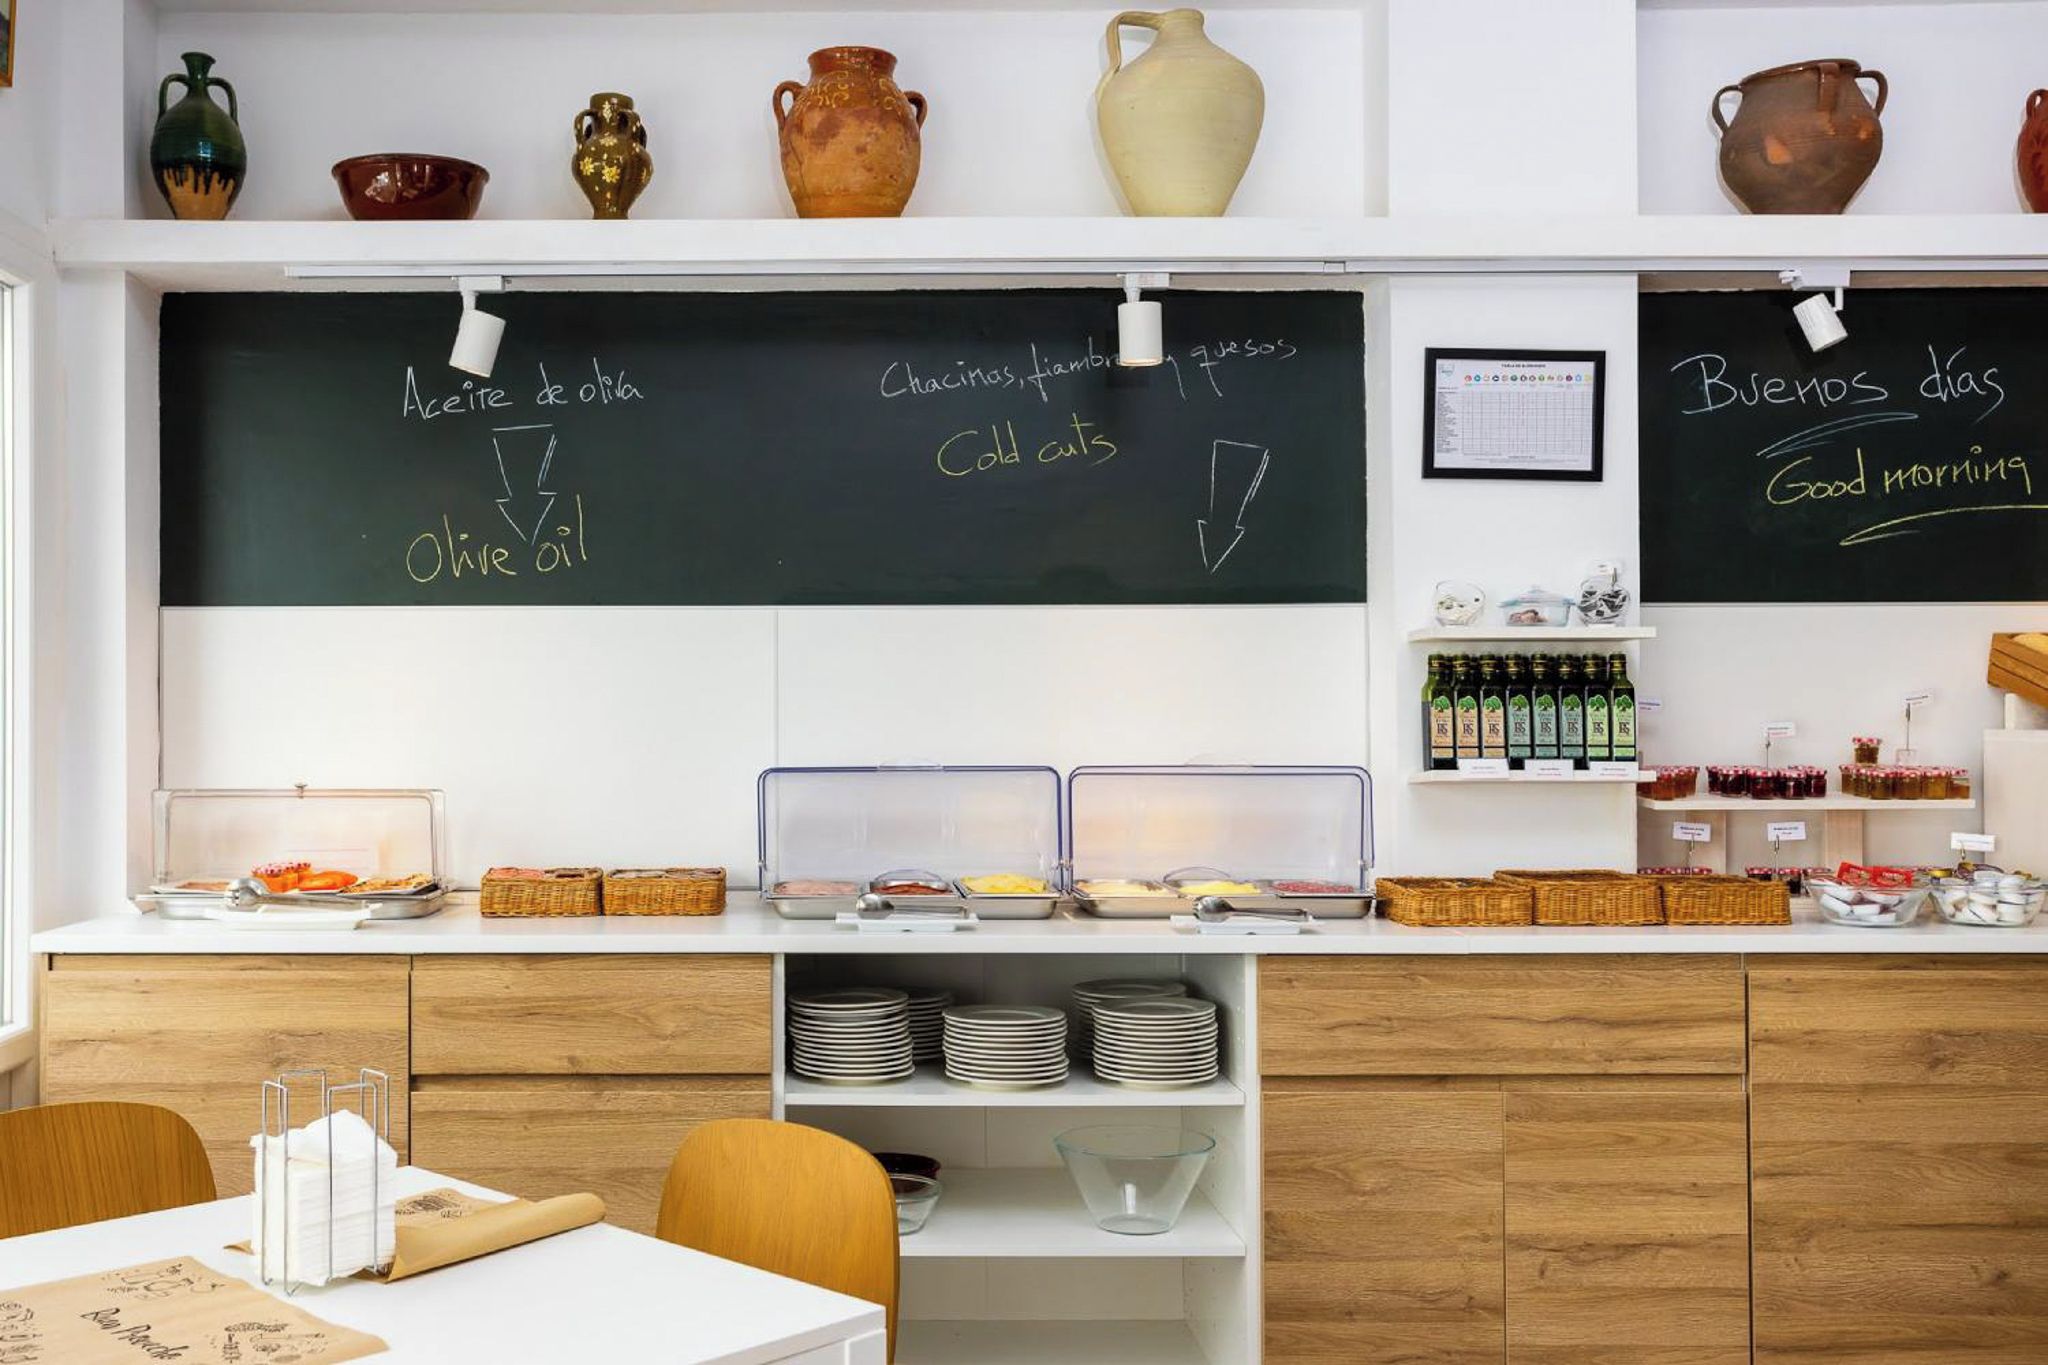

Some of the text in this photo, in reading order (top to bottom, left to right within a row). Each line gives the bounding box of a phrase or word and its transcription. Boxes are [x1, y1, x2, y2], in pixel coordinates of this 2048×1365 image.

[403, 356, 645, 420] Aceite de oliva
[1027, 337, 1120, 402] fiambr
[1190, 339, 1297, 397] quesos
[1671, 345, 2004, 426] Buenos días
[937, 412, 1117, 476] Cold cuts
[1766, 445, 2032, 505] Good morning
[406, 494, 587, 582] Olive oil
